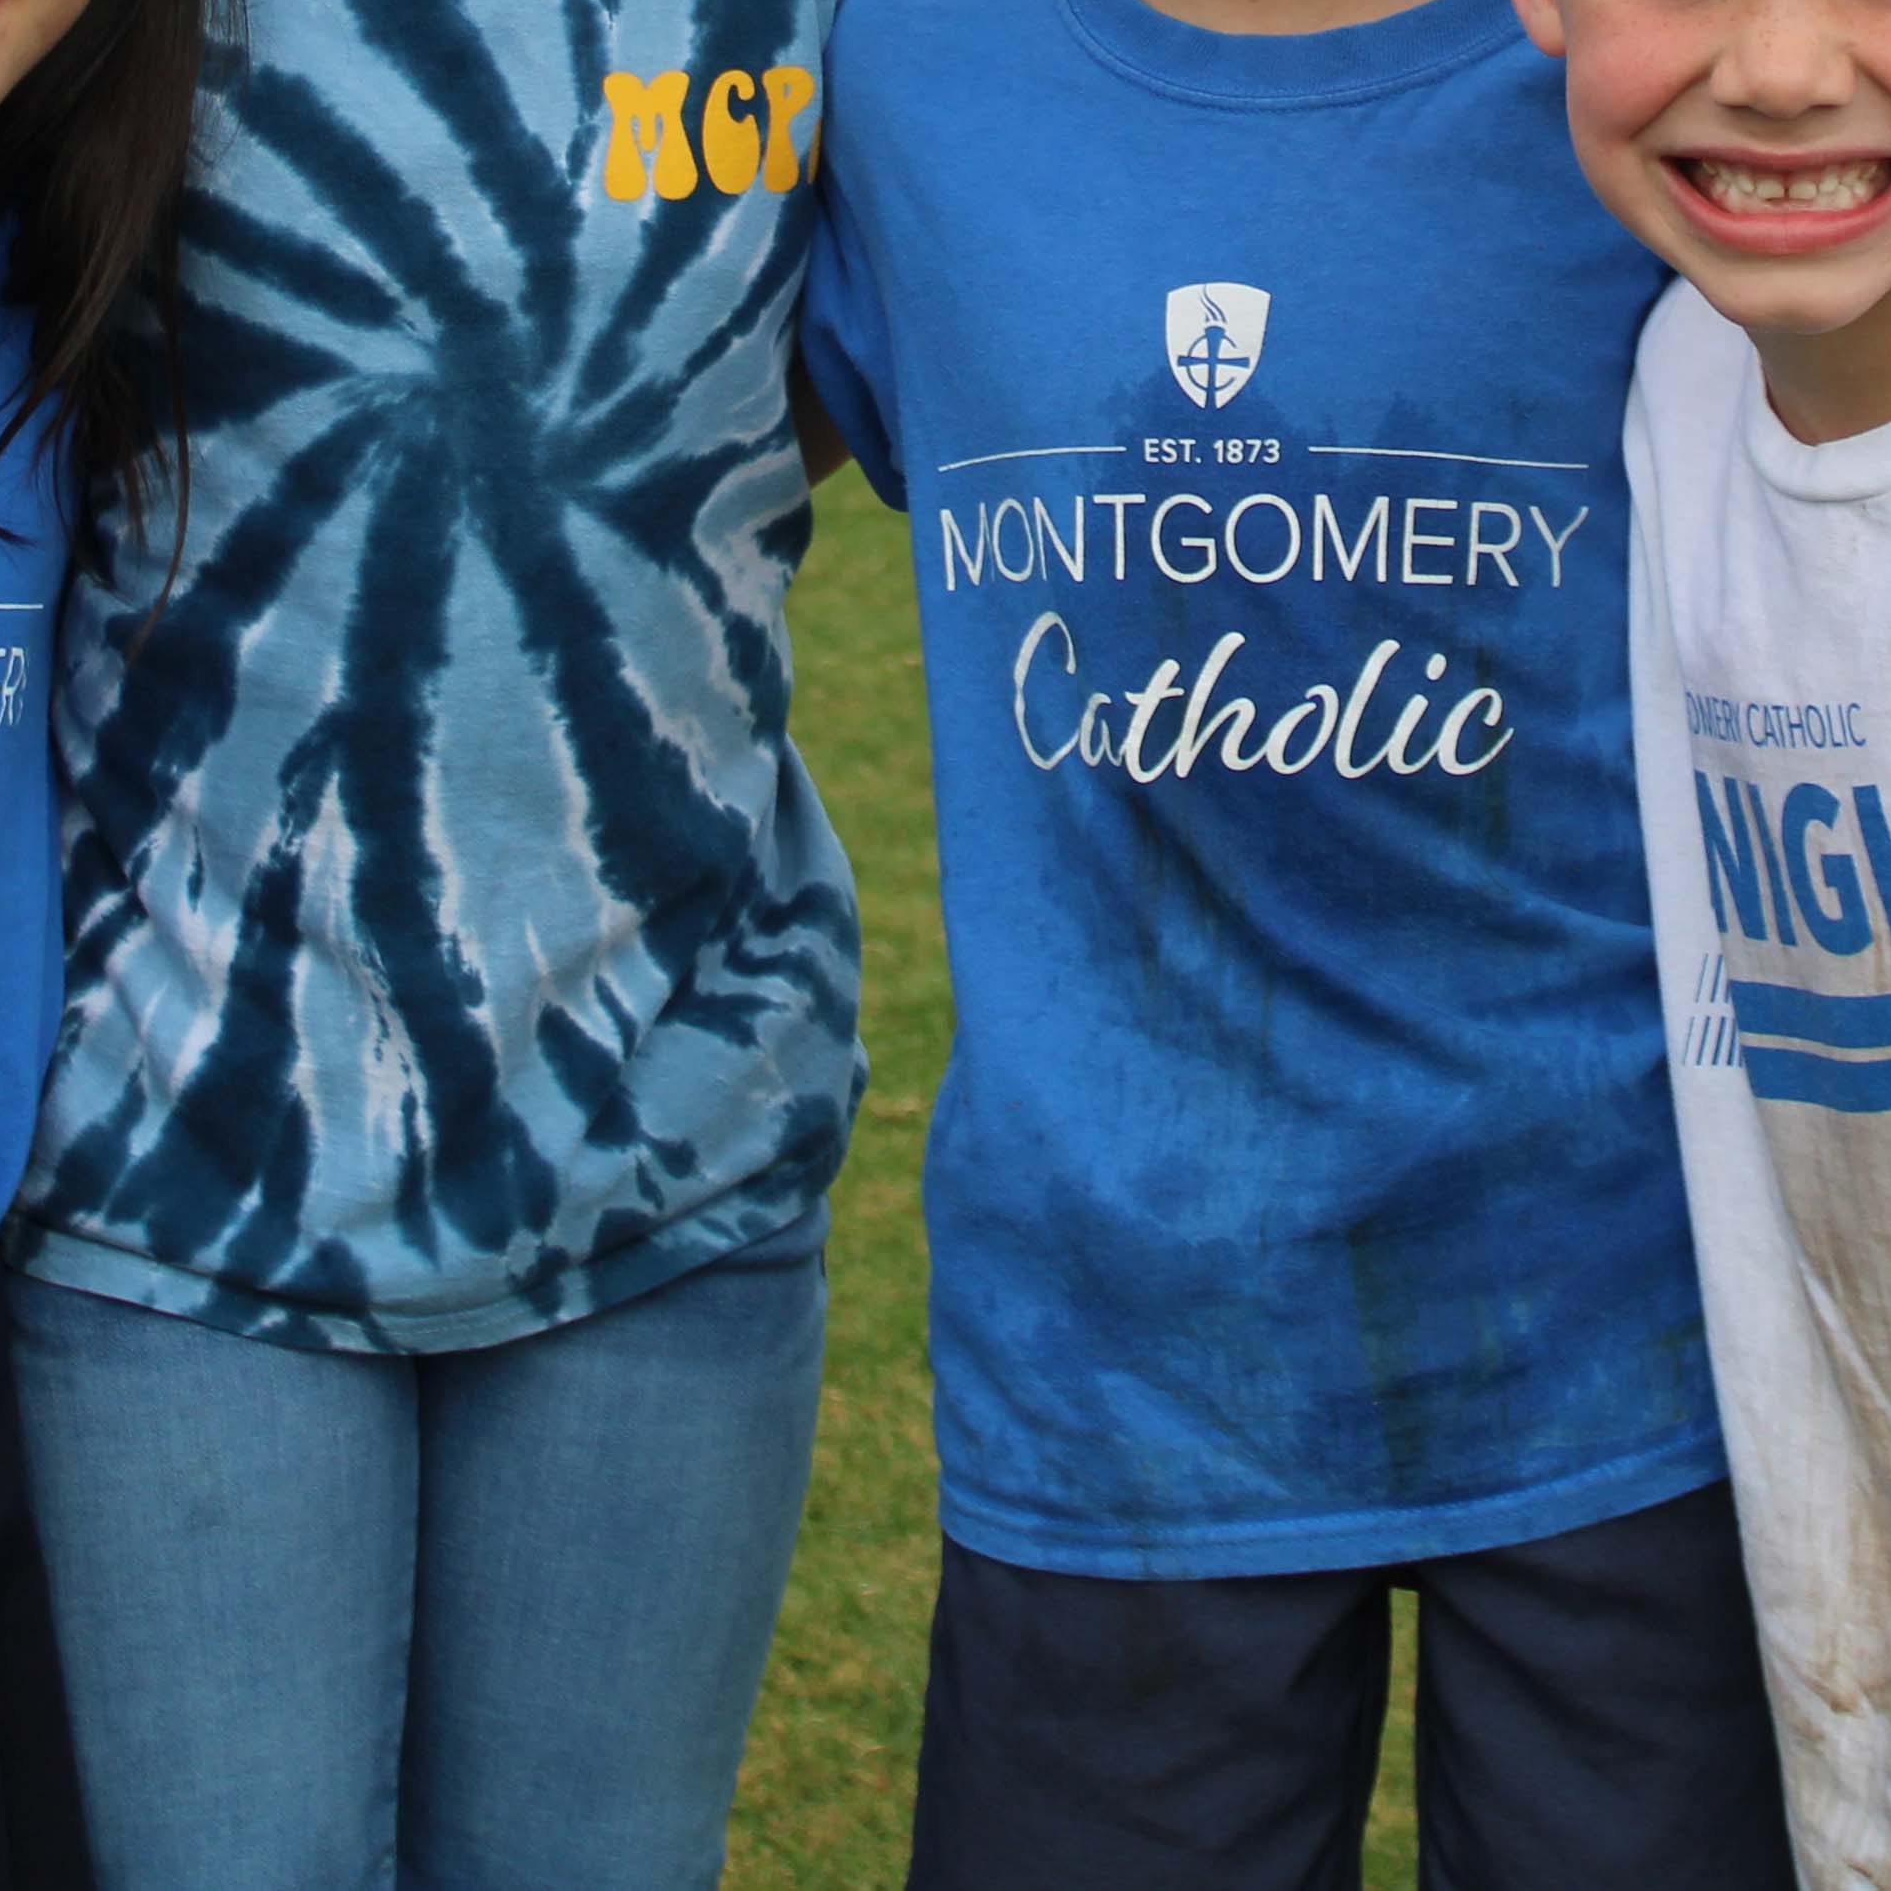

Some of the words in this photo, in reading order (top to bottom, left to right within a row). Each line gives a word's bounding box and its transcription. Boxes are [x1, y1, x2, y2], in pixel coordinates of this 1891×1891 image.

[603, 66, 822, 201] MCP
[1144, 437, 1202, 464] EST.
[1213, 437, 1280, 464] 1873
[940, 494, 1589, 591] MONTGOMERY
[1013, 611, 1514, 783] Catholic
[1746, 702, 1867, 749] CATHOLIC
